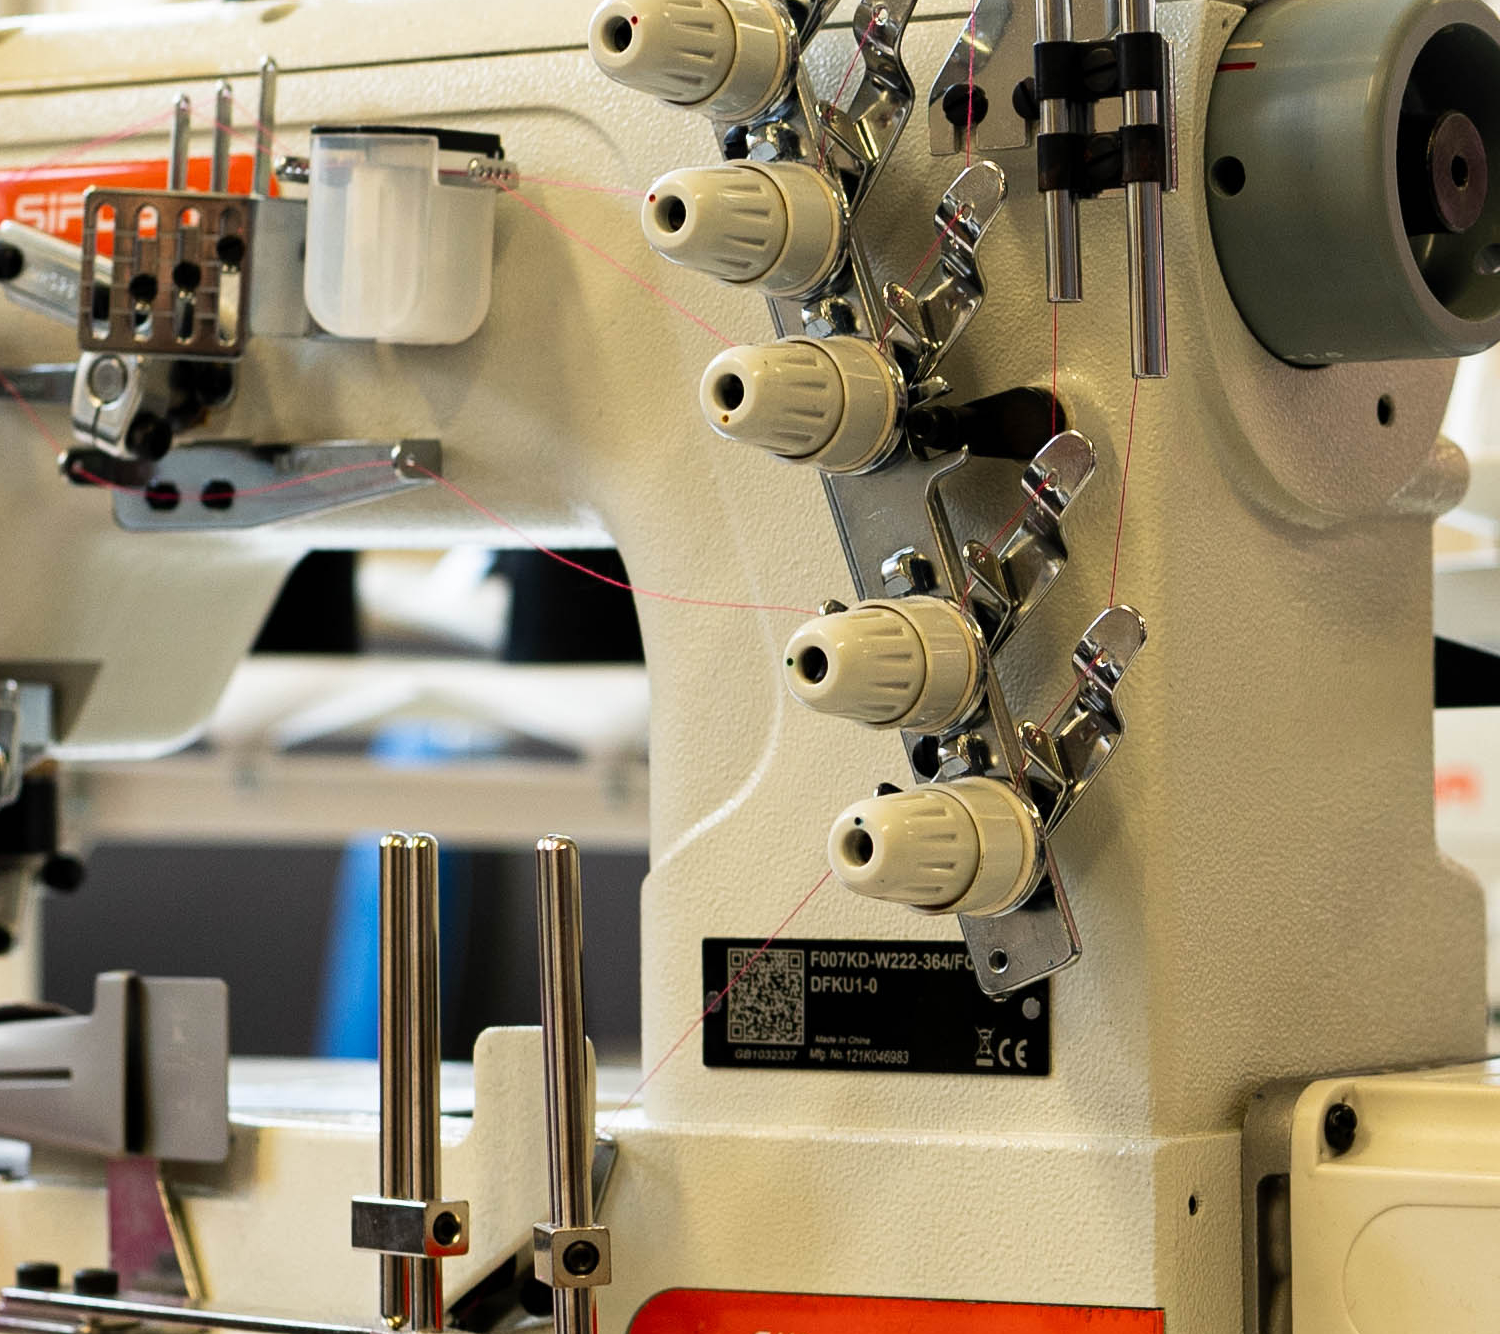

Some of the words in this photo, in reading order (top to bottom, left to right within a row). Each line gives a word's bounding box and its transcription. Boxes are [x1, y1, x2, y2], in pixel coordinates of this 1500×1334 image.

[810, 976, 878, 994] DFKU1-0
[814, 1034, 837, 1044] Made
[847, 1035, 871, 1046] China
